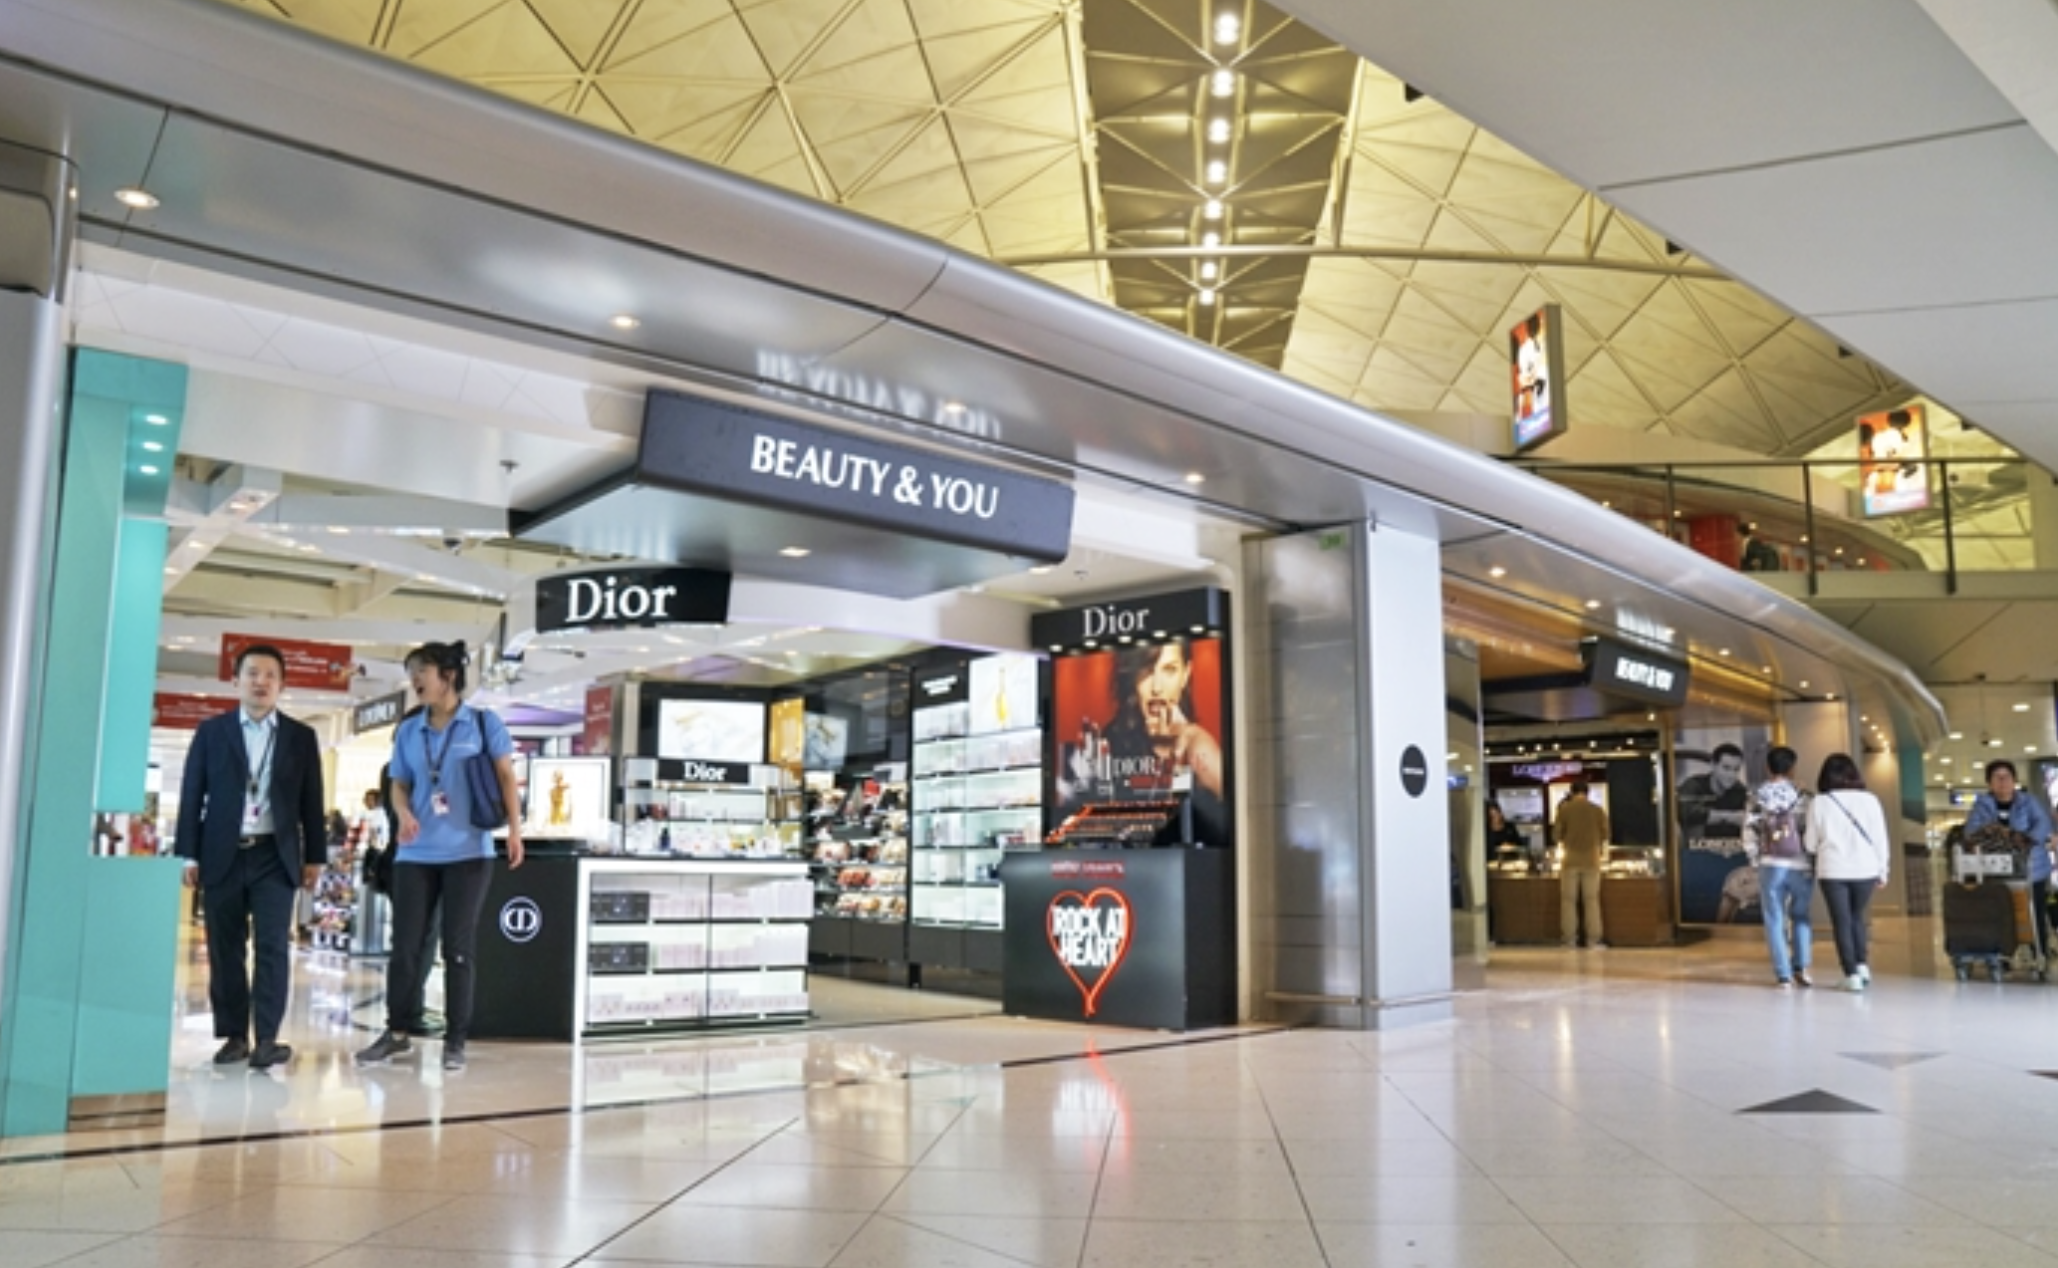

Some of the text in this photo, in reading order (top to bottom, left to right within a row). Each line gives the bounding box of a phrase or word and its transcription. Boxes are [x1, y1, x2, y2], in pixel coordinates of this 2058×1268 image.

[751, 433, 999, 519] BEAUTY & YOU
[565, 576, 677, 623] Dior
[1083, 604, 1150, 637] Dior
[684, 761, 727, 781] Dior
[1052, 906, 1126, 938] ROCK AT
[1059, 934, 1118, 967] HEART
